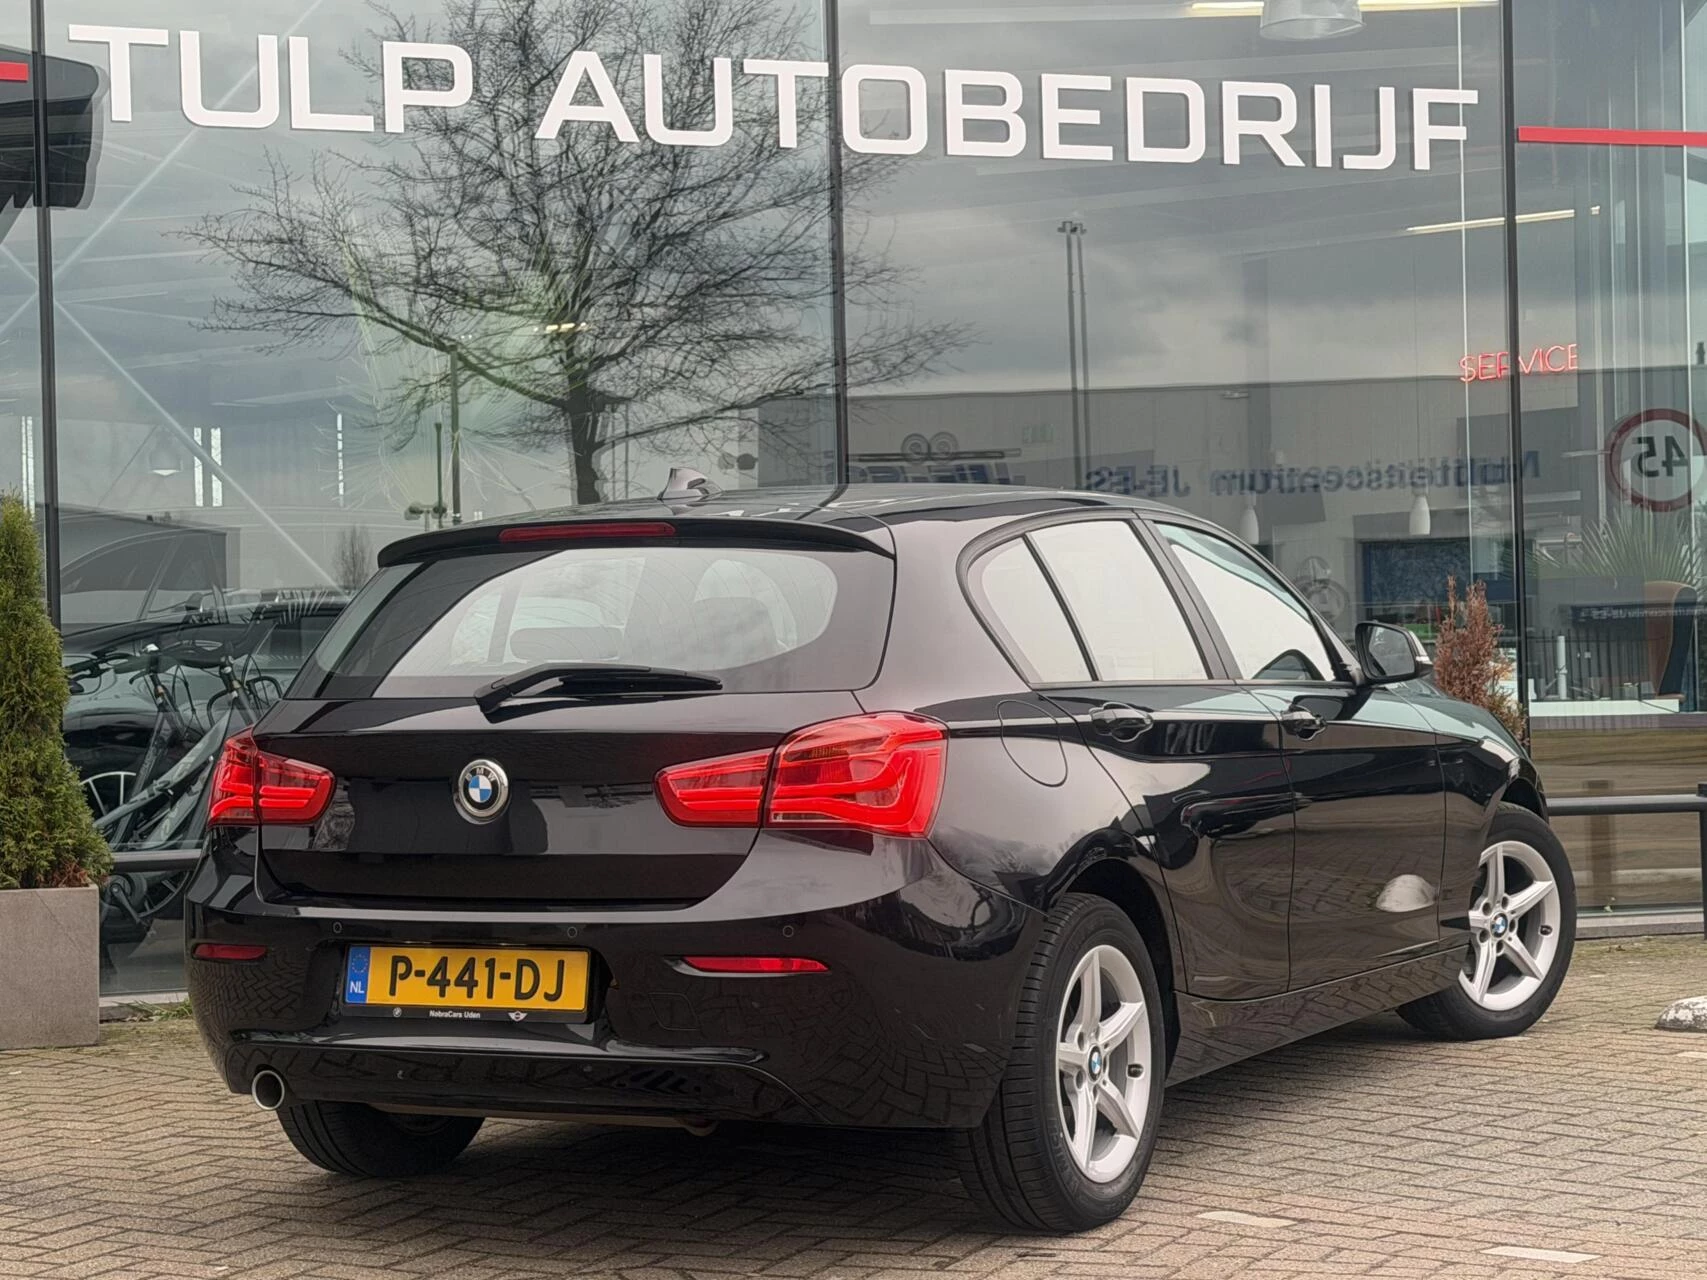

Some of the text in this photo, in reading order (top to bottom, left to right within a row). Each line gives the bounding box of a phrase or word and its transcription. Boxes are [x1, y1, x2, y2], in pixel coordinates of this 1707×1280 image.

[68, 24, 1479, 172] TULP AUTOBEDRIJF
[465, 767, 496, 782] BMW
[349, 981, 365, 994] NL
[389, 955, 565, 1002] P-441-DJ
